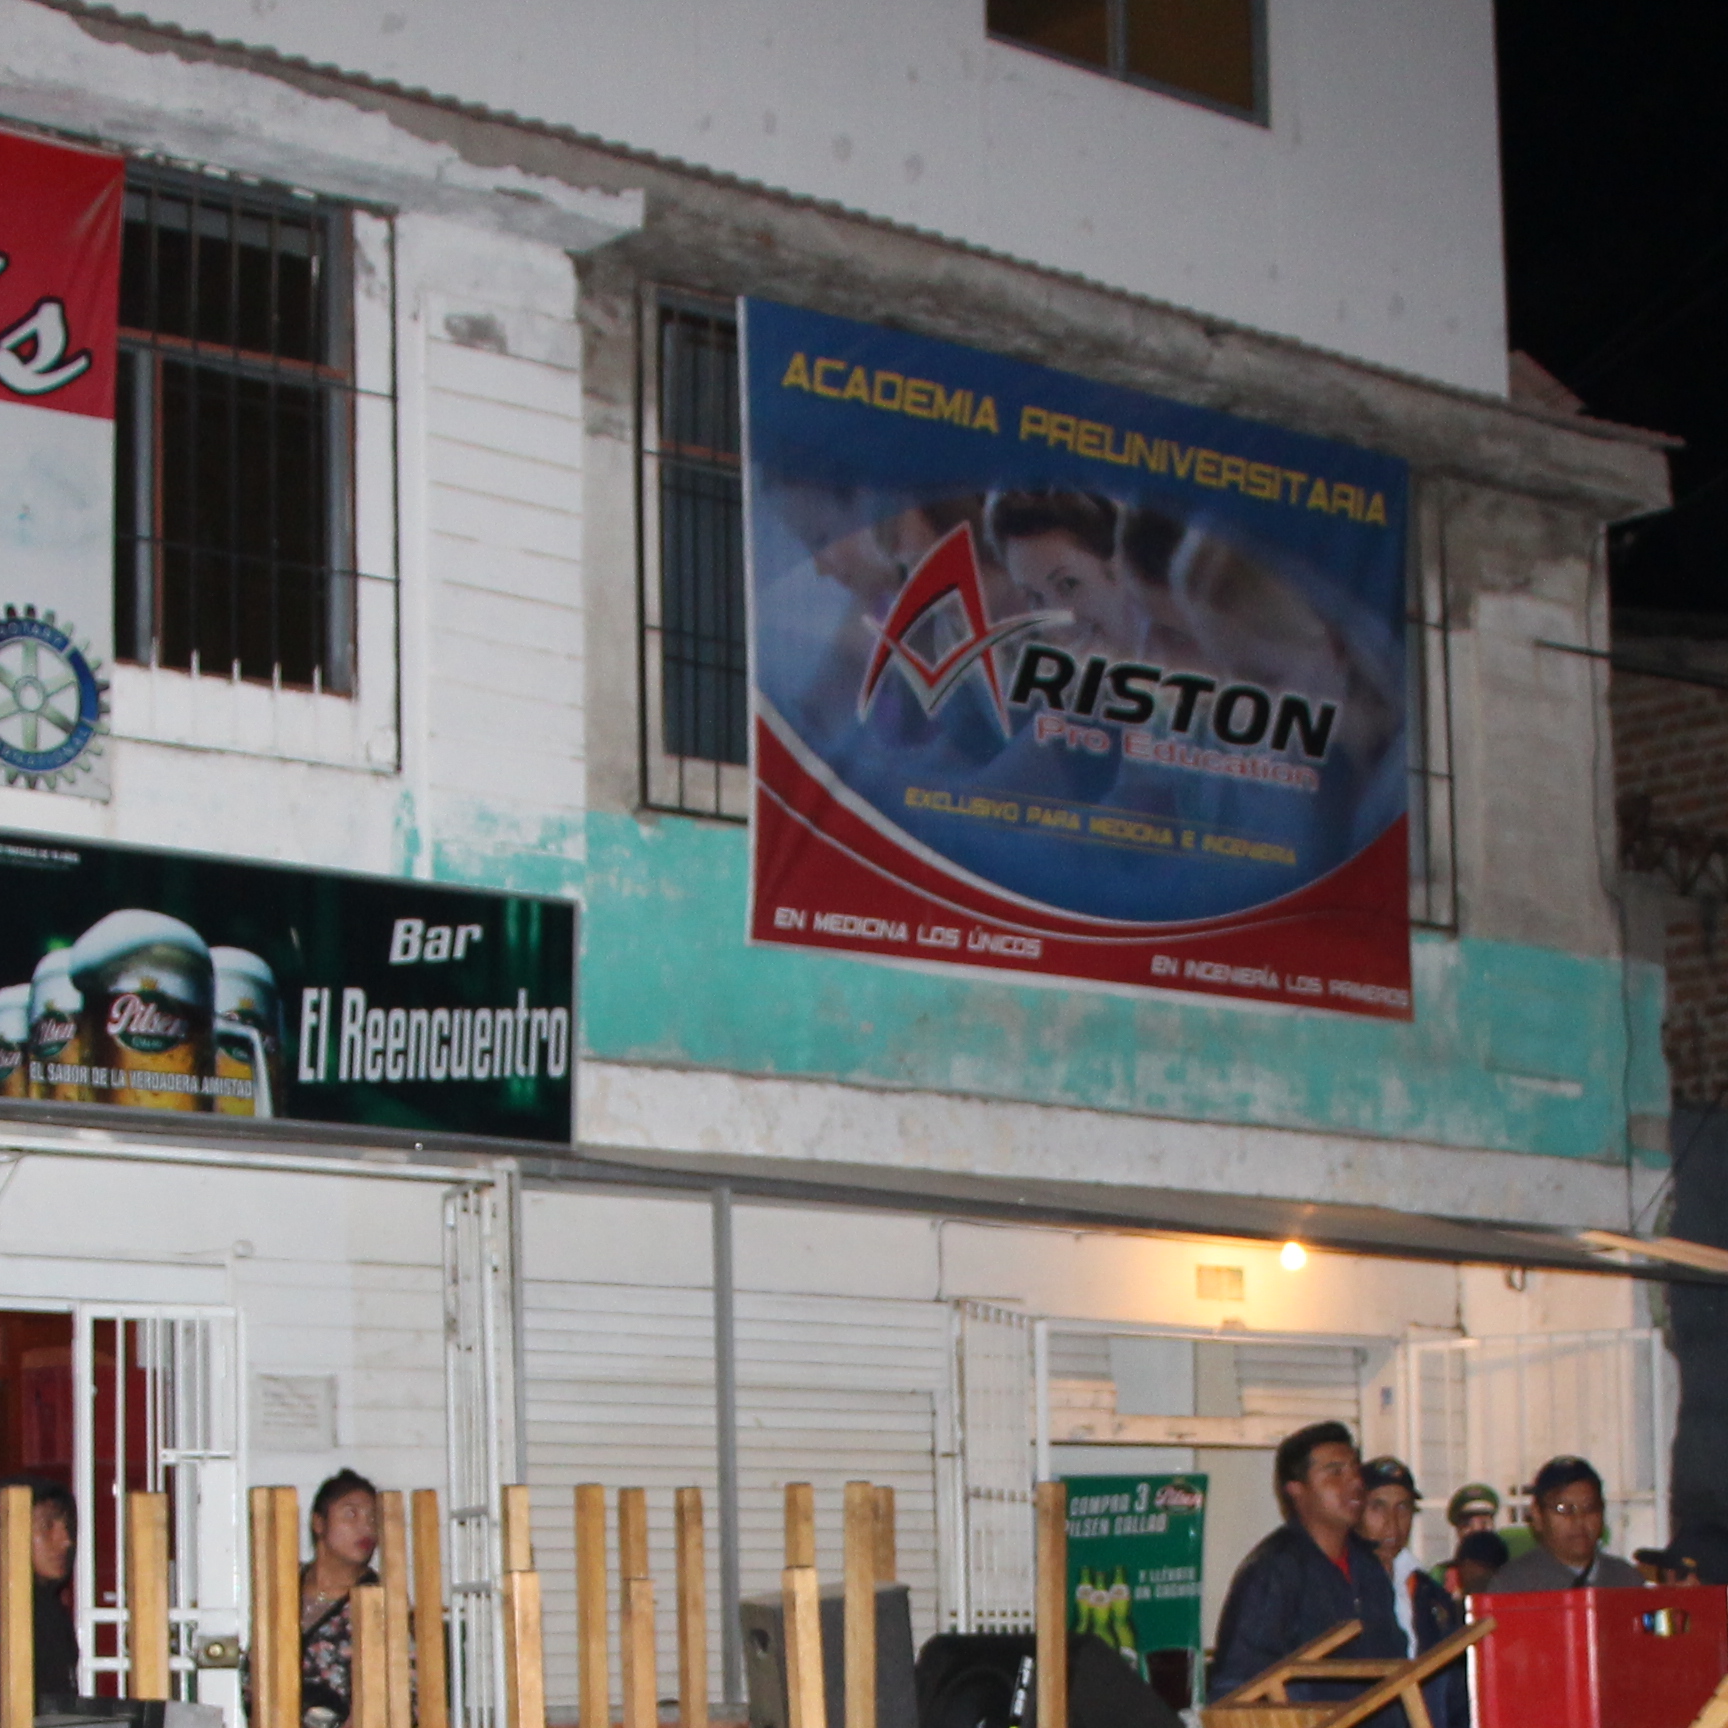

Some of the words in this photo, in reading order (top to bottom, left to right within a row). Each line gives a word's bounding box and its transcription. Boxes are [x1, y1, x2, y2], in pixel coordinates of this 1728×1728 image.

[780, 351, 999, 434] ACADEMIA
[1020, 407, 1387, 526] PREUNIVERSITARIA
[1035, 714, 1112, 752] Pro
[1124, 731, 1320, 791] Education
[1026, 806, 1080, 830] PARA
[389, 917, 483, 965] Bar
[774, 906, 806, 930] EN
[813, 910, 909, 942] MEDICINA
[917, 924, 960, 949] LOS
[967, 925, 1043, 959] ÚNICOS
[1151, 954, 1178, 975] EN
[1184, 960, 1280, 990] INGENIERÍA
[1285, 975, 1322, 996] LOS
[1329, 979, 1410, 1007] PRIMEROS
[298, 987, 331, 1082] El
[339, 986, 569, 1081] Reencuentro
[29, 1061, 44, 1081] EL
[47, 1063, 89, 1084] SABOR
[91, 1066, 107, 1086] DE
[111, 1068, 126, 1088] LA
[128, 1069, 198, 1093] VERDADERA
[201, 1077, 253, 1098] AMISTAD
[1134, 1482, 1150, 1512] 3
